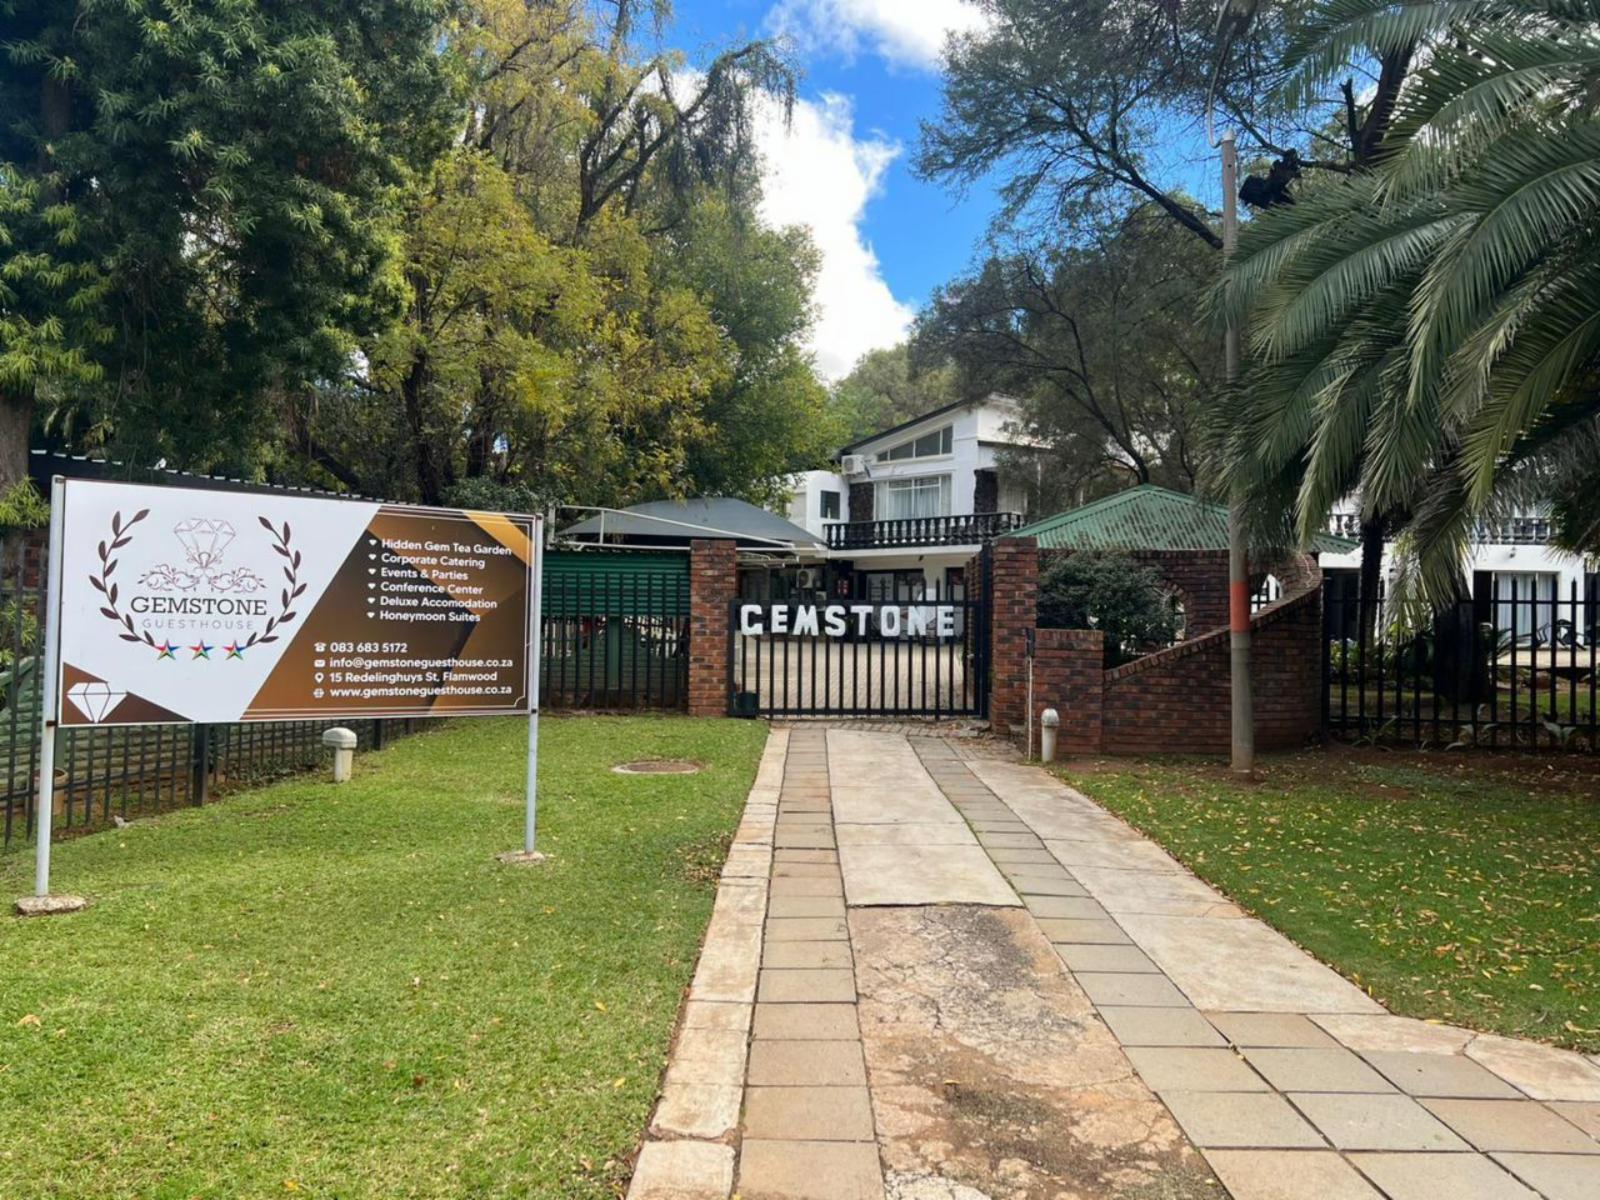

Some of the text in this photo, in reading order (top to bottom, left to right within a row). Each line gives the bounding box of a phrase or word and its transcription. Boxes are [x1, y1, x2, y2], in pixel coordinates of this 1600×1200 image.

[381, 538, 512, 556] Hidden Gem Tea Garden
[381, 553, 485, 569] Corporate Catering
[381, 567, 469, 581] Events & Parties
[380, 581, 484, 595] Conference Center
[130, 596, 268, 616] GEMSTONE
[380, 596, 498, 609] Deluxe Accomodation
[380, 610, 481, 623] Honeymoon Suites
[740, 604, 955, 637] GEMSTONE
[142, 618, 254, 631] GUESTHOUSE
[330, 642, 408, 653] 083 683 5172
[329, 657, 513, 670] info@gemstoneguesthouse.co.za
[329, 672, 342, 683] 15
[345, 671, 423, 684] Redelinghuys
[443, 671, 498, 681] Flamwood
[330, 685, 512, 699] www.gemstoneguesthouse.co.za
